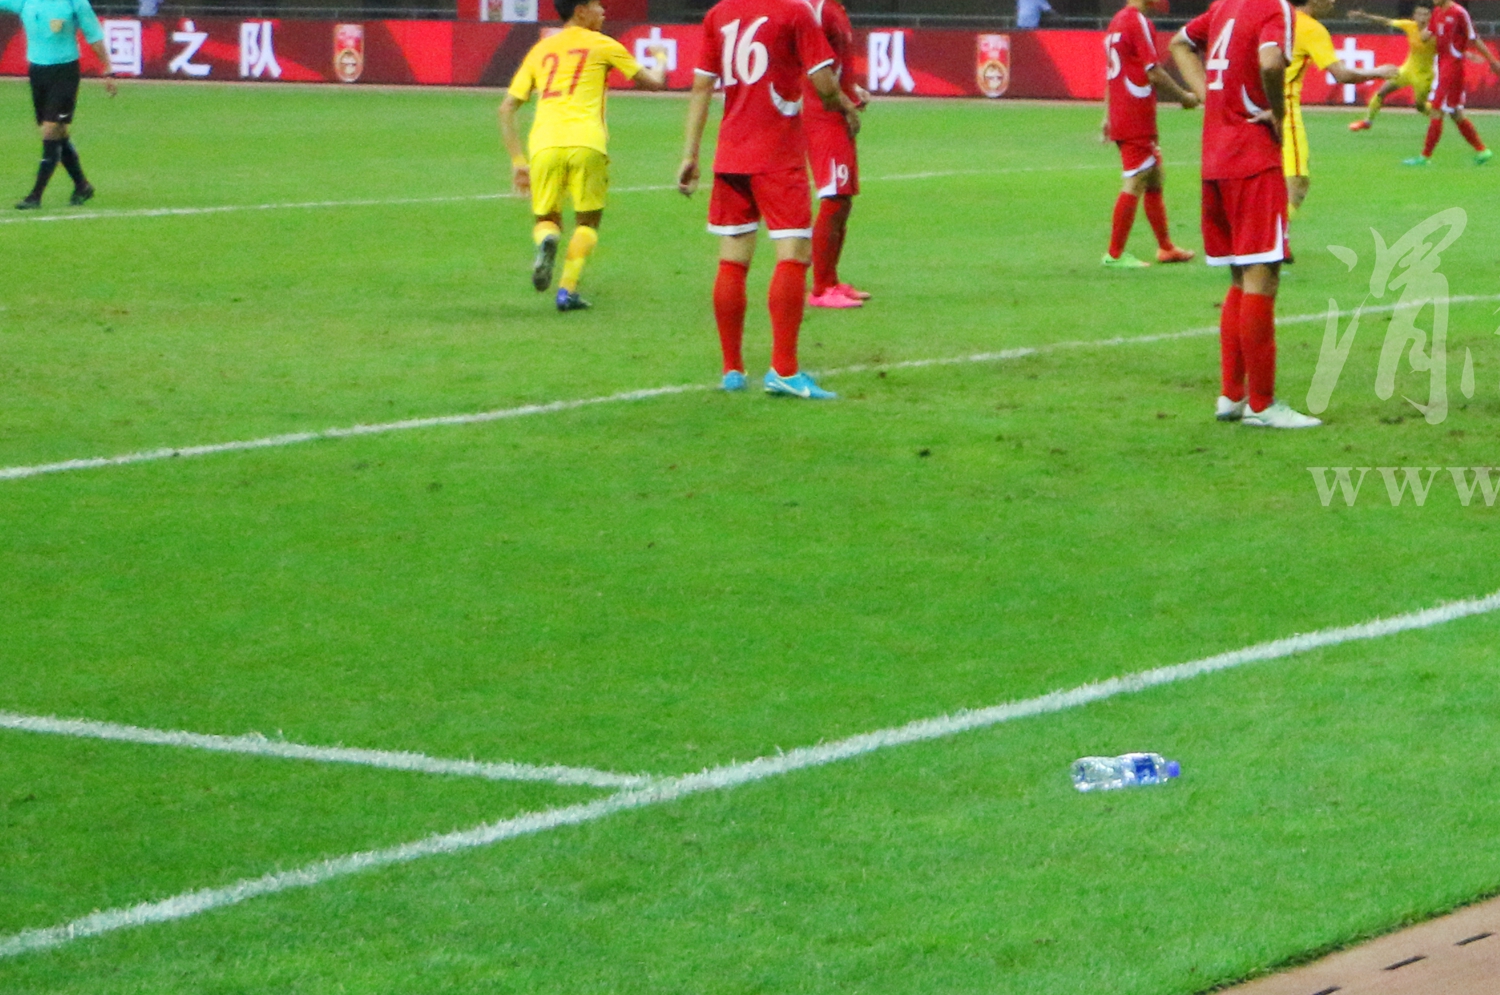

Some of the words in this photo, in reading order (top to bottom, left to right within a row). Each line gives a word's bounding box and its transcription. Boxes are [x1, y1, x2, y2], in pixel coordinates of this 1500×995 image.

[541, 48, 590, 100] 27
[720, 16, 769, 87] 16
[1206, 18, 1236, 91] 4
